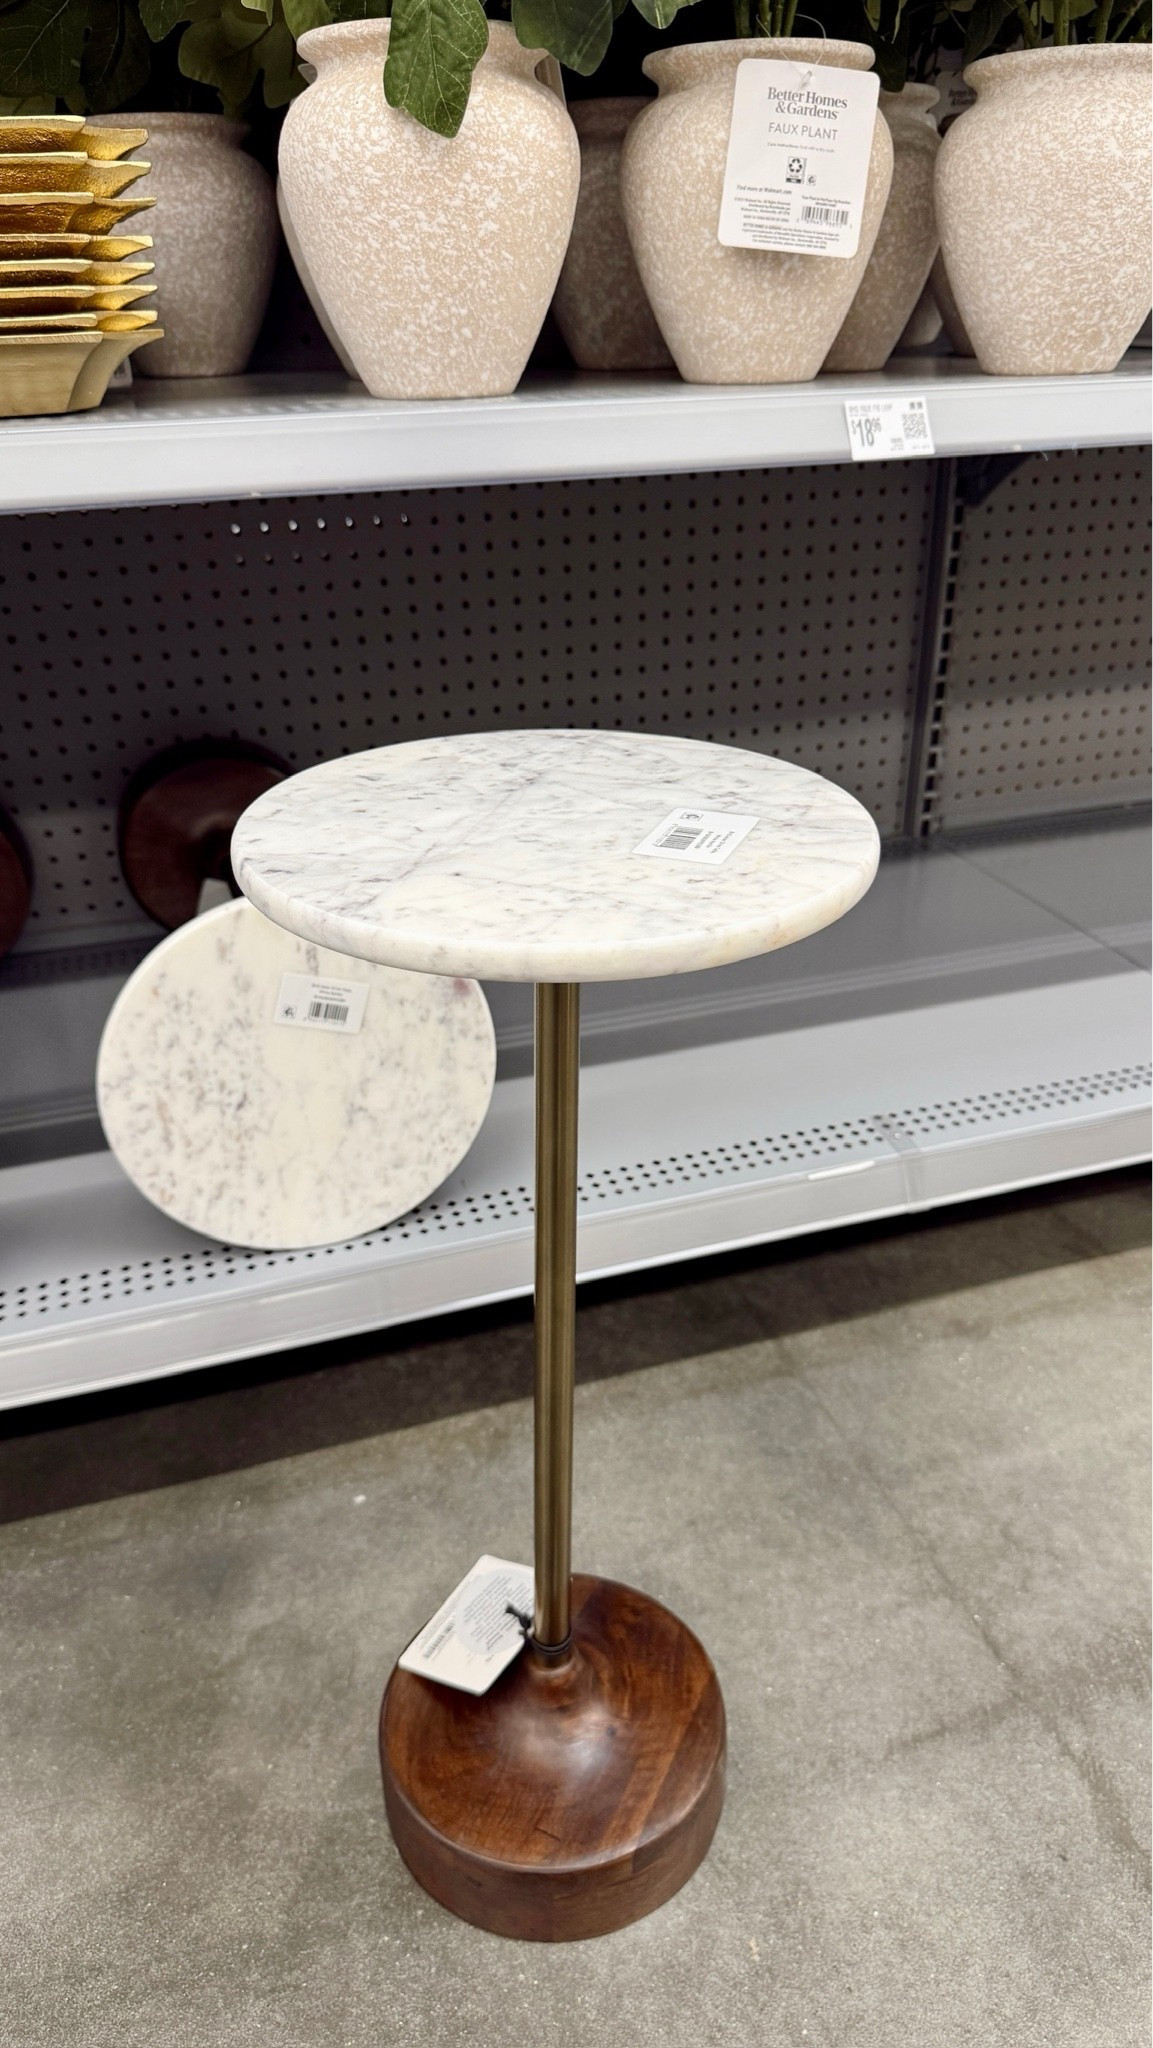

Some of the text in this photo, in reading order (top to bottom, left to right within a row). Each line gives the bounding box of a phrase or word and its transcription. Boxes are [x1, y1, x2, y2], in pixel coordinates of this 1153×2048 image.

[767, 87, 848, 109] Better Homes
[768, 122, 838, 141] FAUX PLANT
